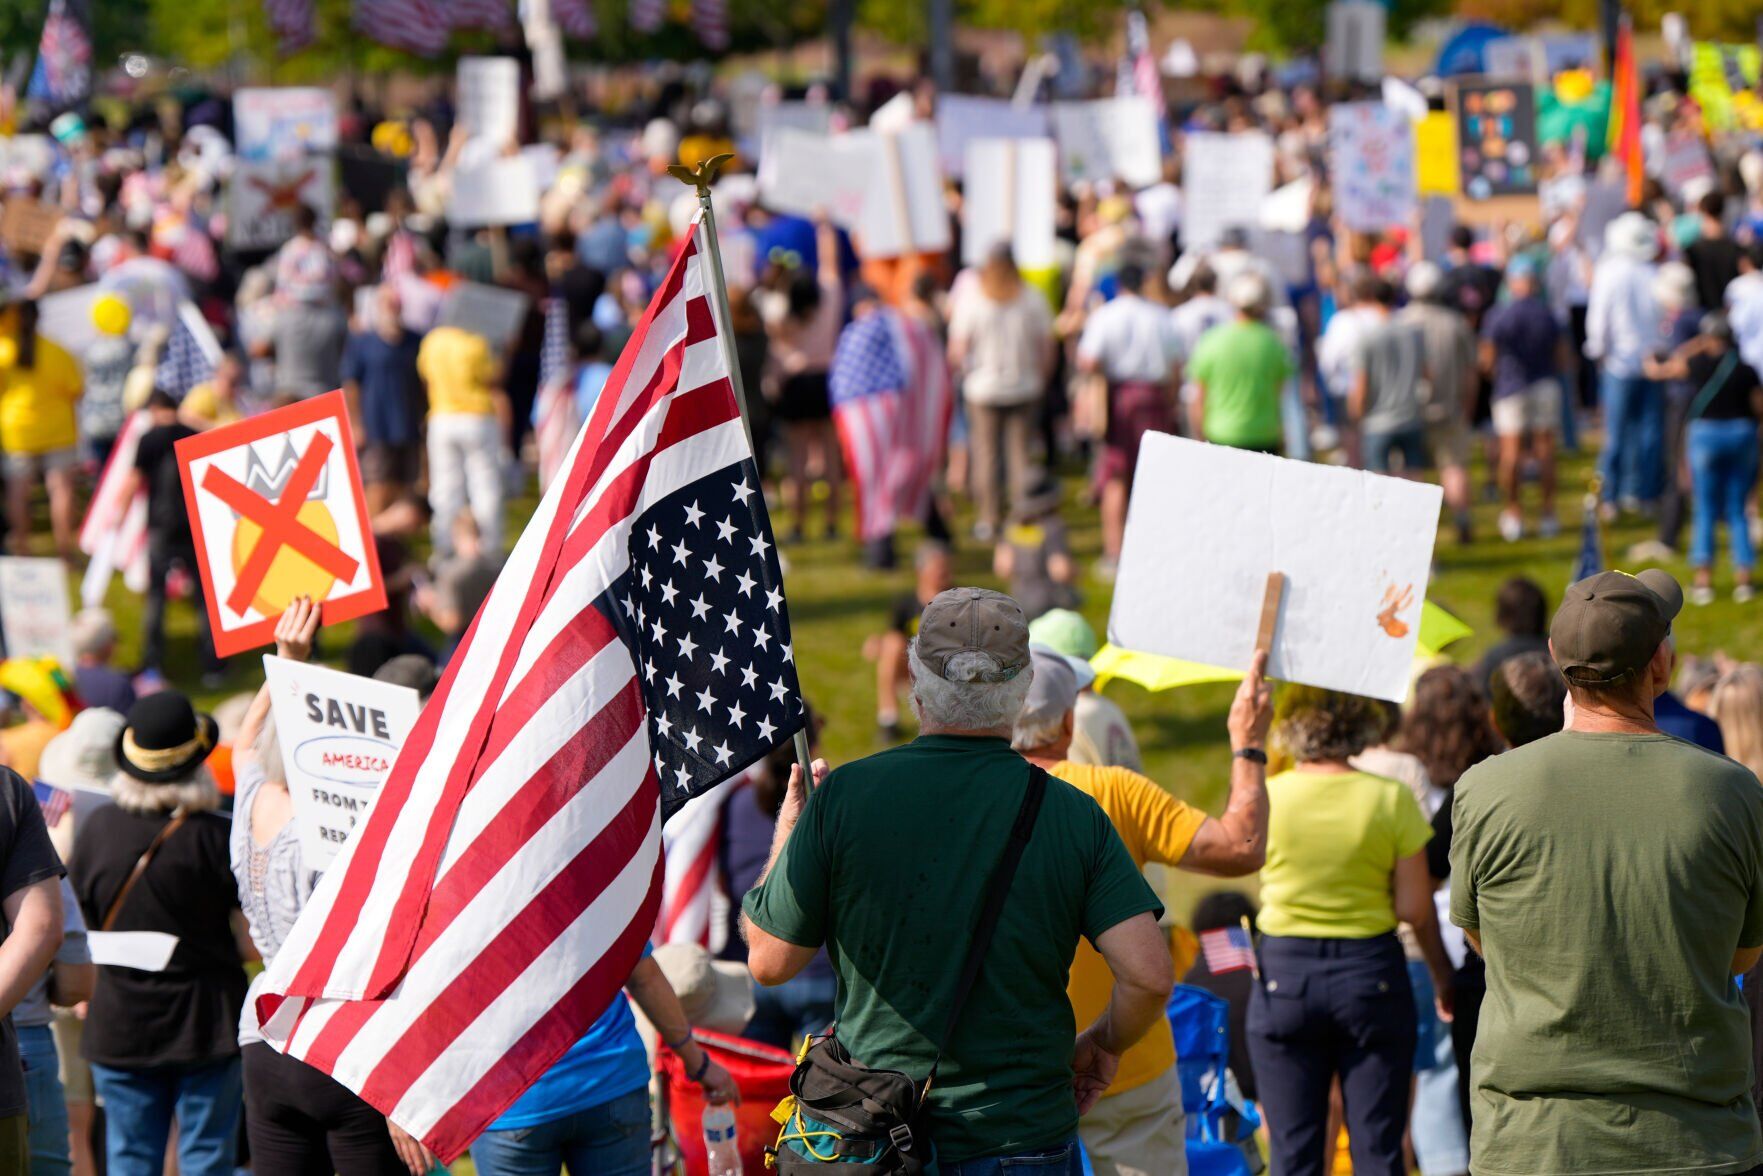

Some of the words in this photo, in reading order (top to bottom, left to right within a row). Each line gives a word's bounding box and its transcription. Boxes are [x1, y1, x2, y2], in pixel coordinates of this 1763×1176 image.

[305, 693, 390, 740] SAVE
[322, 752, 389, 772] AMERICA
[312, 788, 358, 812] FROM
[320, 826, 349, 844] REP
